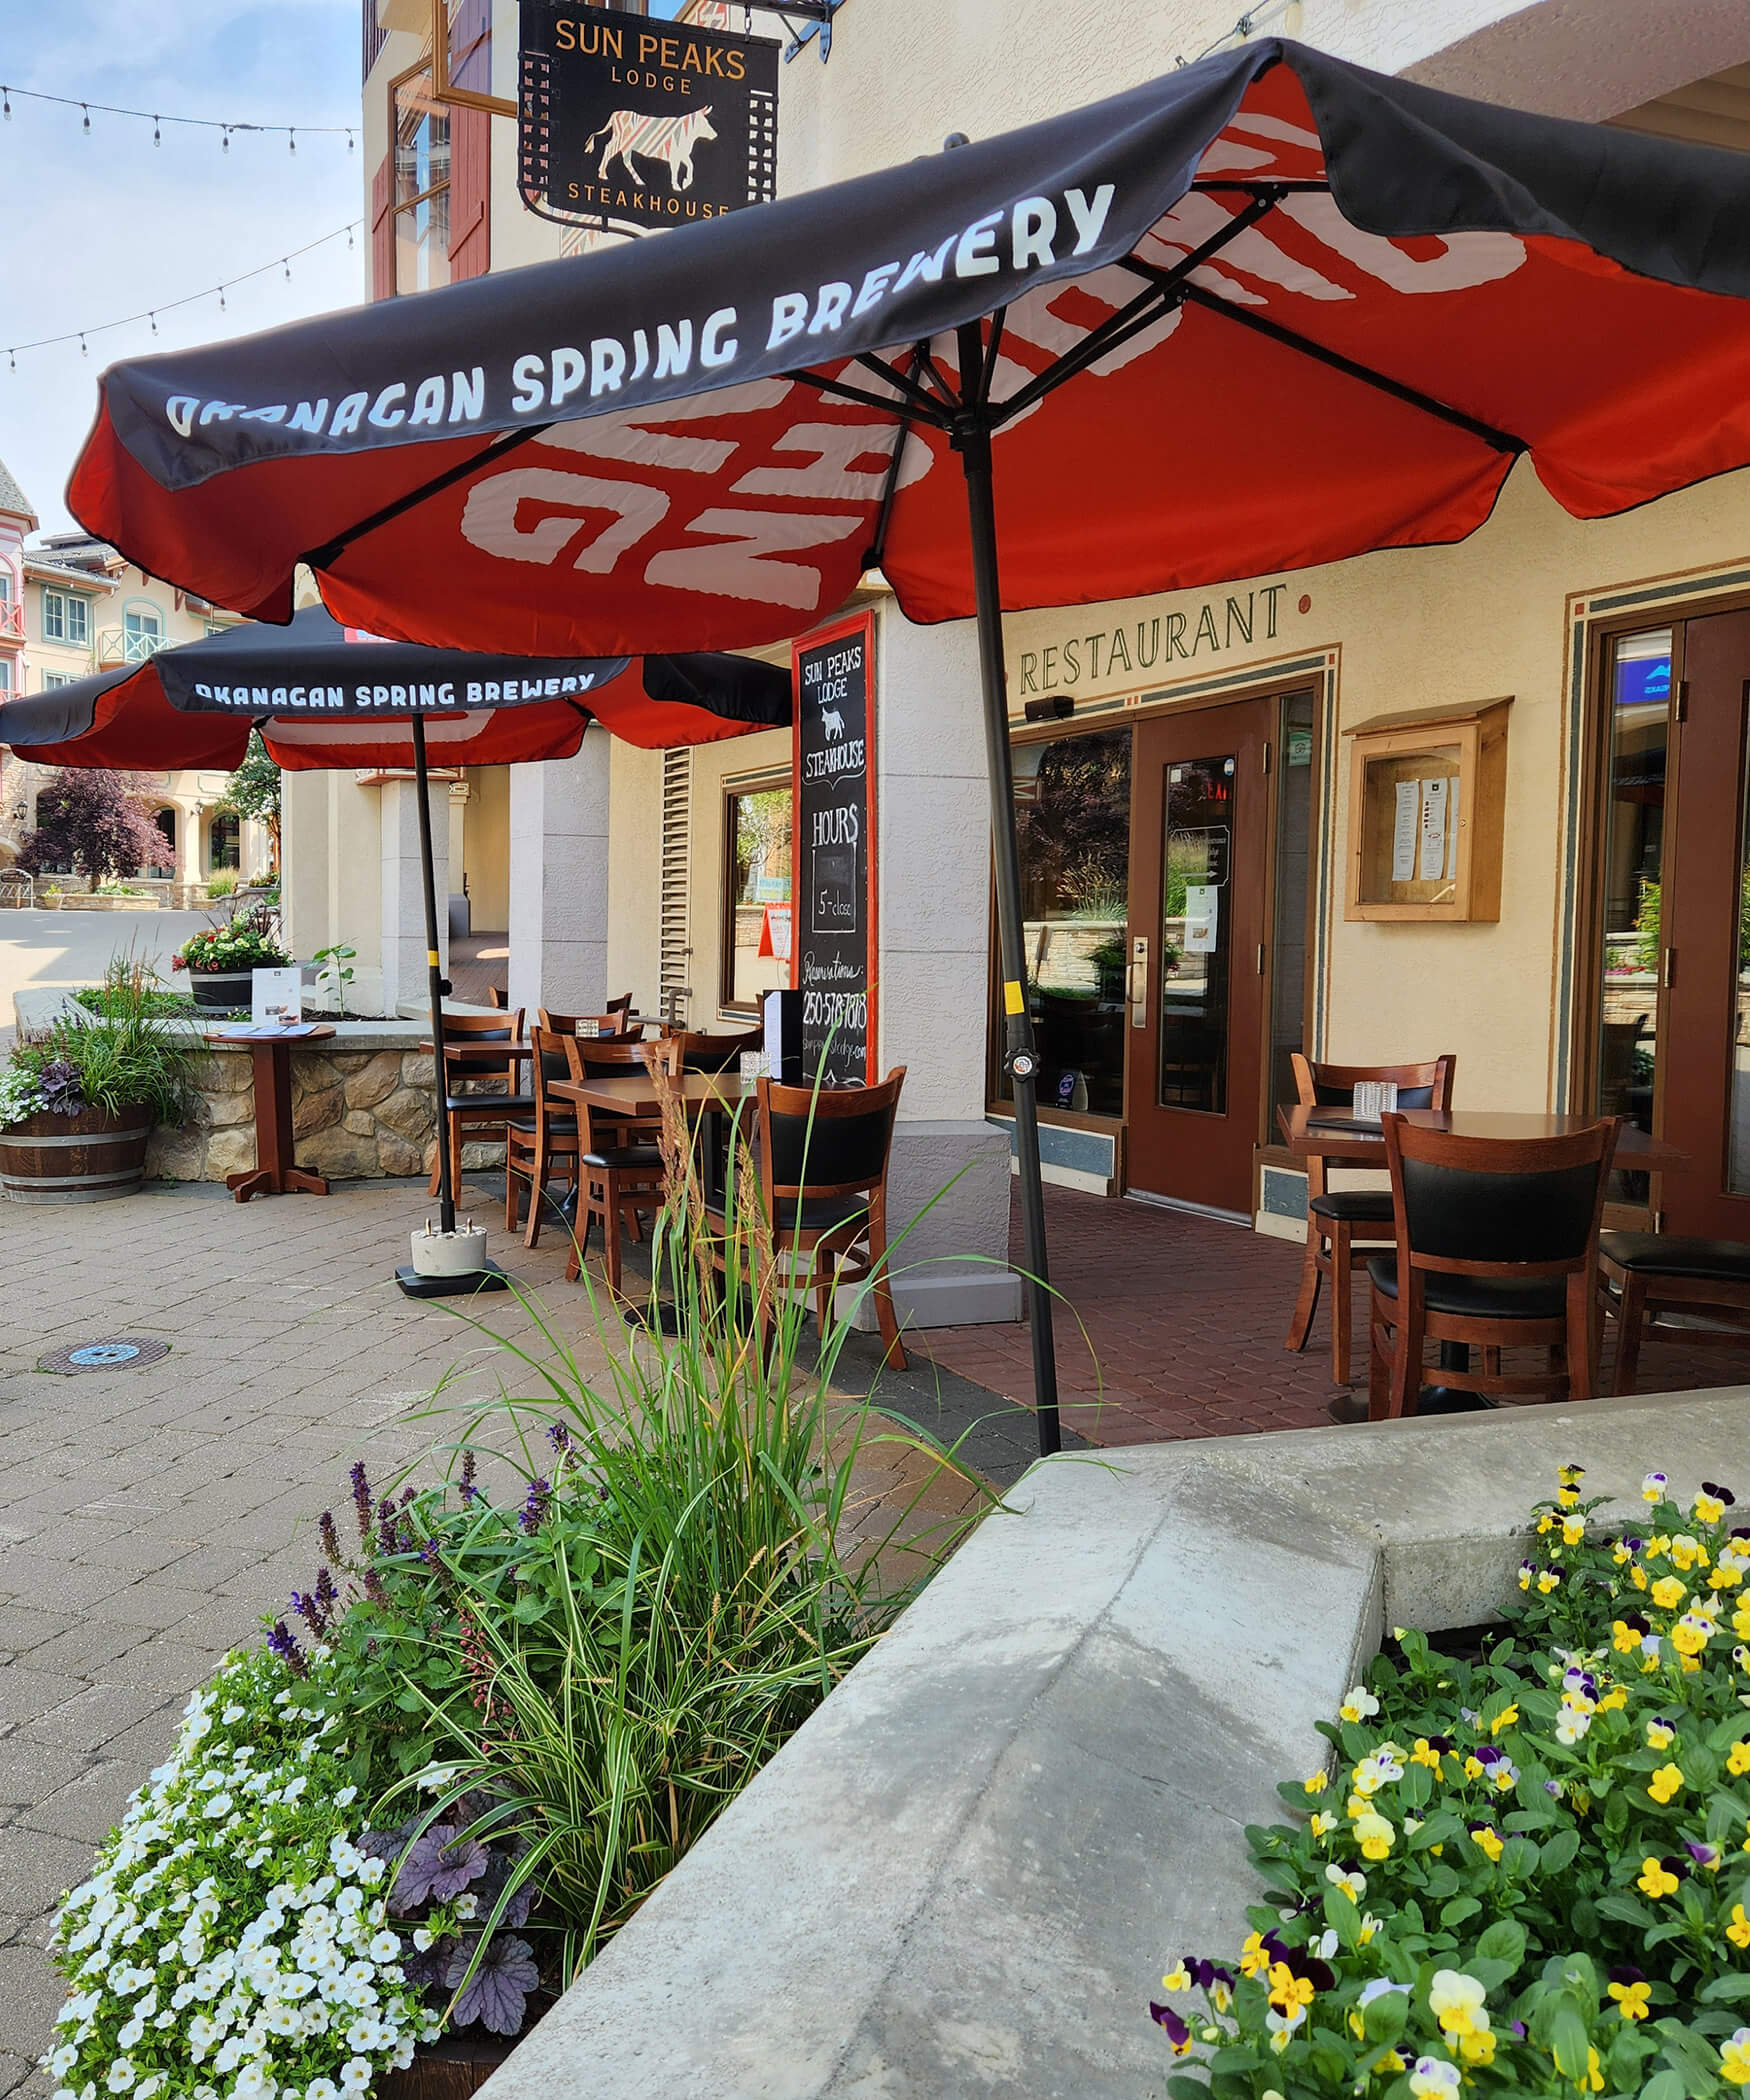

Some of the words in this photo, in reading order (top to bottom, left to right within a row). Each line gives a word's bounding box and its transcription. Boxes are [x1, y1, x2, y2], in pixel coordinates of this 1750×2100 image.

[556, 19, 623, 59] SUN
[639, 34, 746, 80] PEAKS
[610, 67, 691, 95] LODGE
[166, 367, 485, 437] OKANAGAN
[512, 307, 738, 412] SPRING
[766, 183, 1116, 351] BREWERY
[1020, 583, 1287, 695] RESTAURANT
[805, 660, 823, 685] SUN
[828, 646, 862, 678] PEAKS
[194, 684, 344, 708] OKANAGAN
[356, 683, 455, 706] SPRING
[467, 672, 596, 703] BREWERY
[817, 678, 848, 704] LODGE
[806, 740, 864, 778] STEAKHOUSE
[812, 803, 859, 846] HOURS
